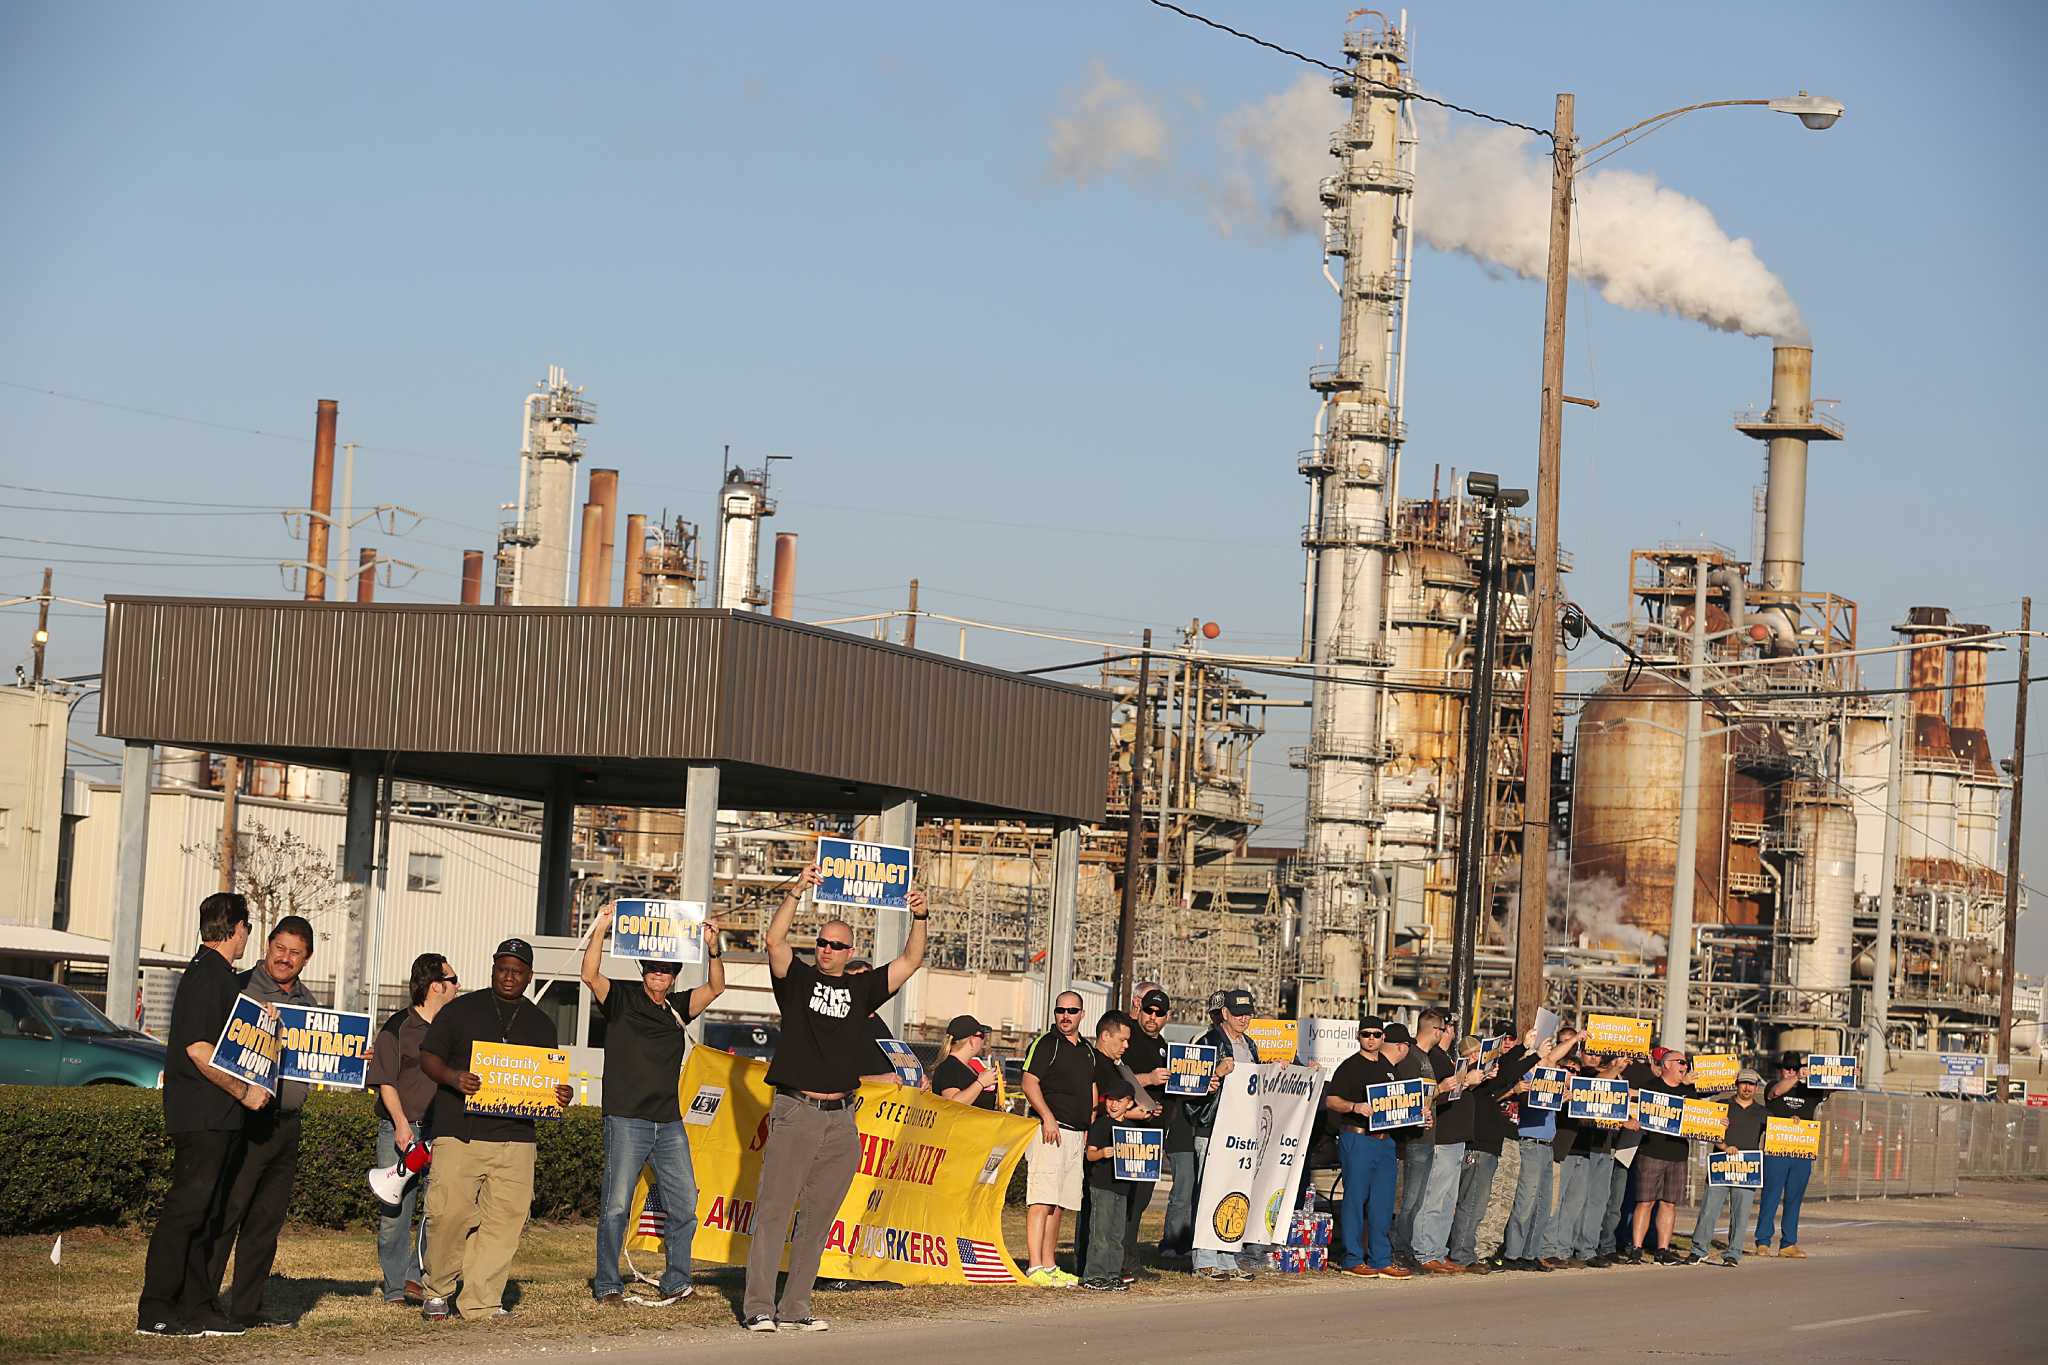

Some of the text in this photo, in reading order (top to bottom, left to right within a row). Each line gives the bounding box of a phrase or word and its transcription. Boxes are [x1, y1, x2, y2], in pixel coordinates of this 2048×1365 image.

[850, 844, 881, 862] FAIR
[821, 857, 907, 884] CONTRACT
[842, 879, 883, 898] NOW!
[644, 902, 671, 918] FAIR
[618, 915, 698, 938] CONTRACT
[639, 936, 677, 952] NOW!
[305, 1012, 339, 1032] FAIR
[1590, 1021, 1632, 1033] Solidarity
[227, 1018, 279, 1063] CONTRA
[280, 1027, 365, 1057] CONTRACT
[1599, 1033, 1644, 1044] STRENGTH
[547, 1053, 565, 1061] USW
[1185, 1047, 1200, 1060] FAIR
[237, 1048, 272, 1078] NOW!
[297, 1052, 340, 1073] NOW!
[475, 1052, 539, 1072] Solidarity
[1171, 1058, 1213, 1076] CONTRACT
[1824, 1057, 1841, 1066] FAIR
[1811, 1064, 1854, 1077] CONTRACT
[488, 1071, 560, 1090] STRENGTH
[1180, 1075, 1200, 1088] NOW!
[1532, 1079, 1564, 1094] CONTRACT
[1591, 1080, 1611, 1091] FAIR
[1821, 1075, 1842, 1084] NOW!
[1387, 1084, 1405, 1096] FAIR
[1573, 1089, 1627, 1104] CONTRACT
[691, 1096, 720, 1113] USW
[1372, 1092, 1421, 1112] CONTRACT
[1653, 1094, 1670, 1106] FAIR
[1386, 1108, 1408, 1121] NOW!
[1586, 1103, 1612, 1113] NOW!
[1641, 1101, 1682, 1120] CONTRACT
[1649, 1115, 1668, 1127] NOW!
[1126, 1131, 1143, 1144] FAIR
[1280, 1134, 1299, 1147] Loc
[1116, 1142, 1159, 1160] CONTRACT
[1125, 1160, 1145, 1172] NOW!
[1238, 1153, 1295, 1169] 13 22
[1711, 1161, 1760, 1173] CONTRACT
[1725, 1172, 1748, 1182] NOW!
